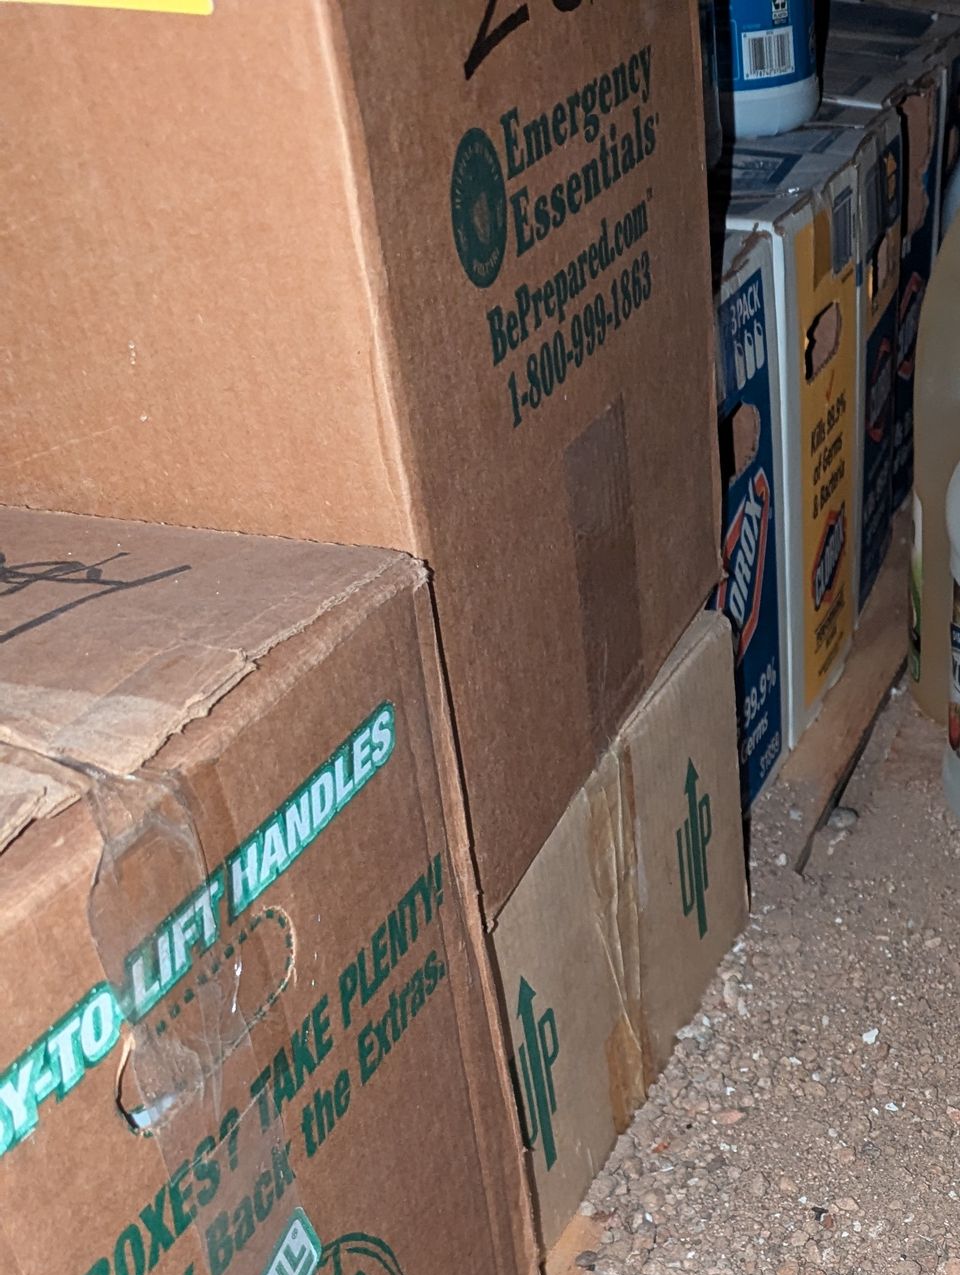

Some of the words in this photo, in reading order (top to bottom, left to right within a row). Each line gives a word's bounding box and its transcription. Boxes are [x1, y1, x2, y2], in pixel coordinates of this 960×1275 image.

[500, 44, 651, 180] Emergency
[510, 106, 657, 257] Essentials
[486, 200, 649, 366] BePrepared.com
[507, 250, 652, 429] 1-800-999-1863
[730, 305, 737, 336] 3
[736, 279, 761, 329] PACK
[743, 656, 777, 729] 99.9%
[0, 992, 114, 1156] Y-TO
[128, 880, 220, 1001] LIFT
[228, 708, 395, 905] HANDLES
[251, 994, 334, 1133] TAKE
[338, 851, 444, 1030] PLENTY!
[300, 1068, 351, 1159] the
[357, 949, 446, 1087] Extras.
